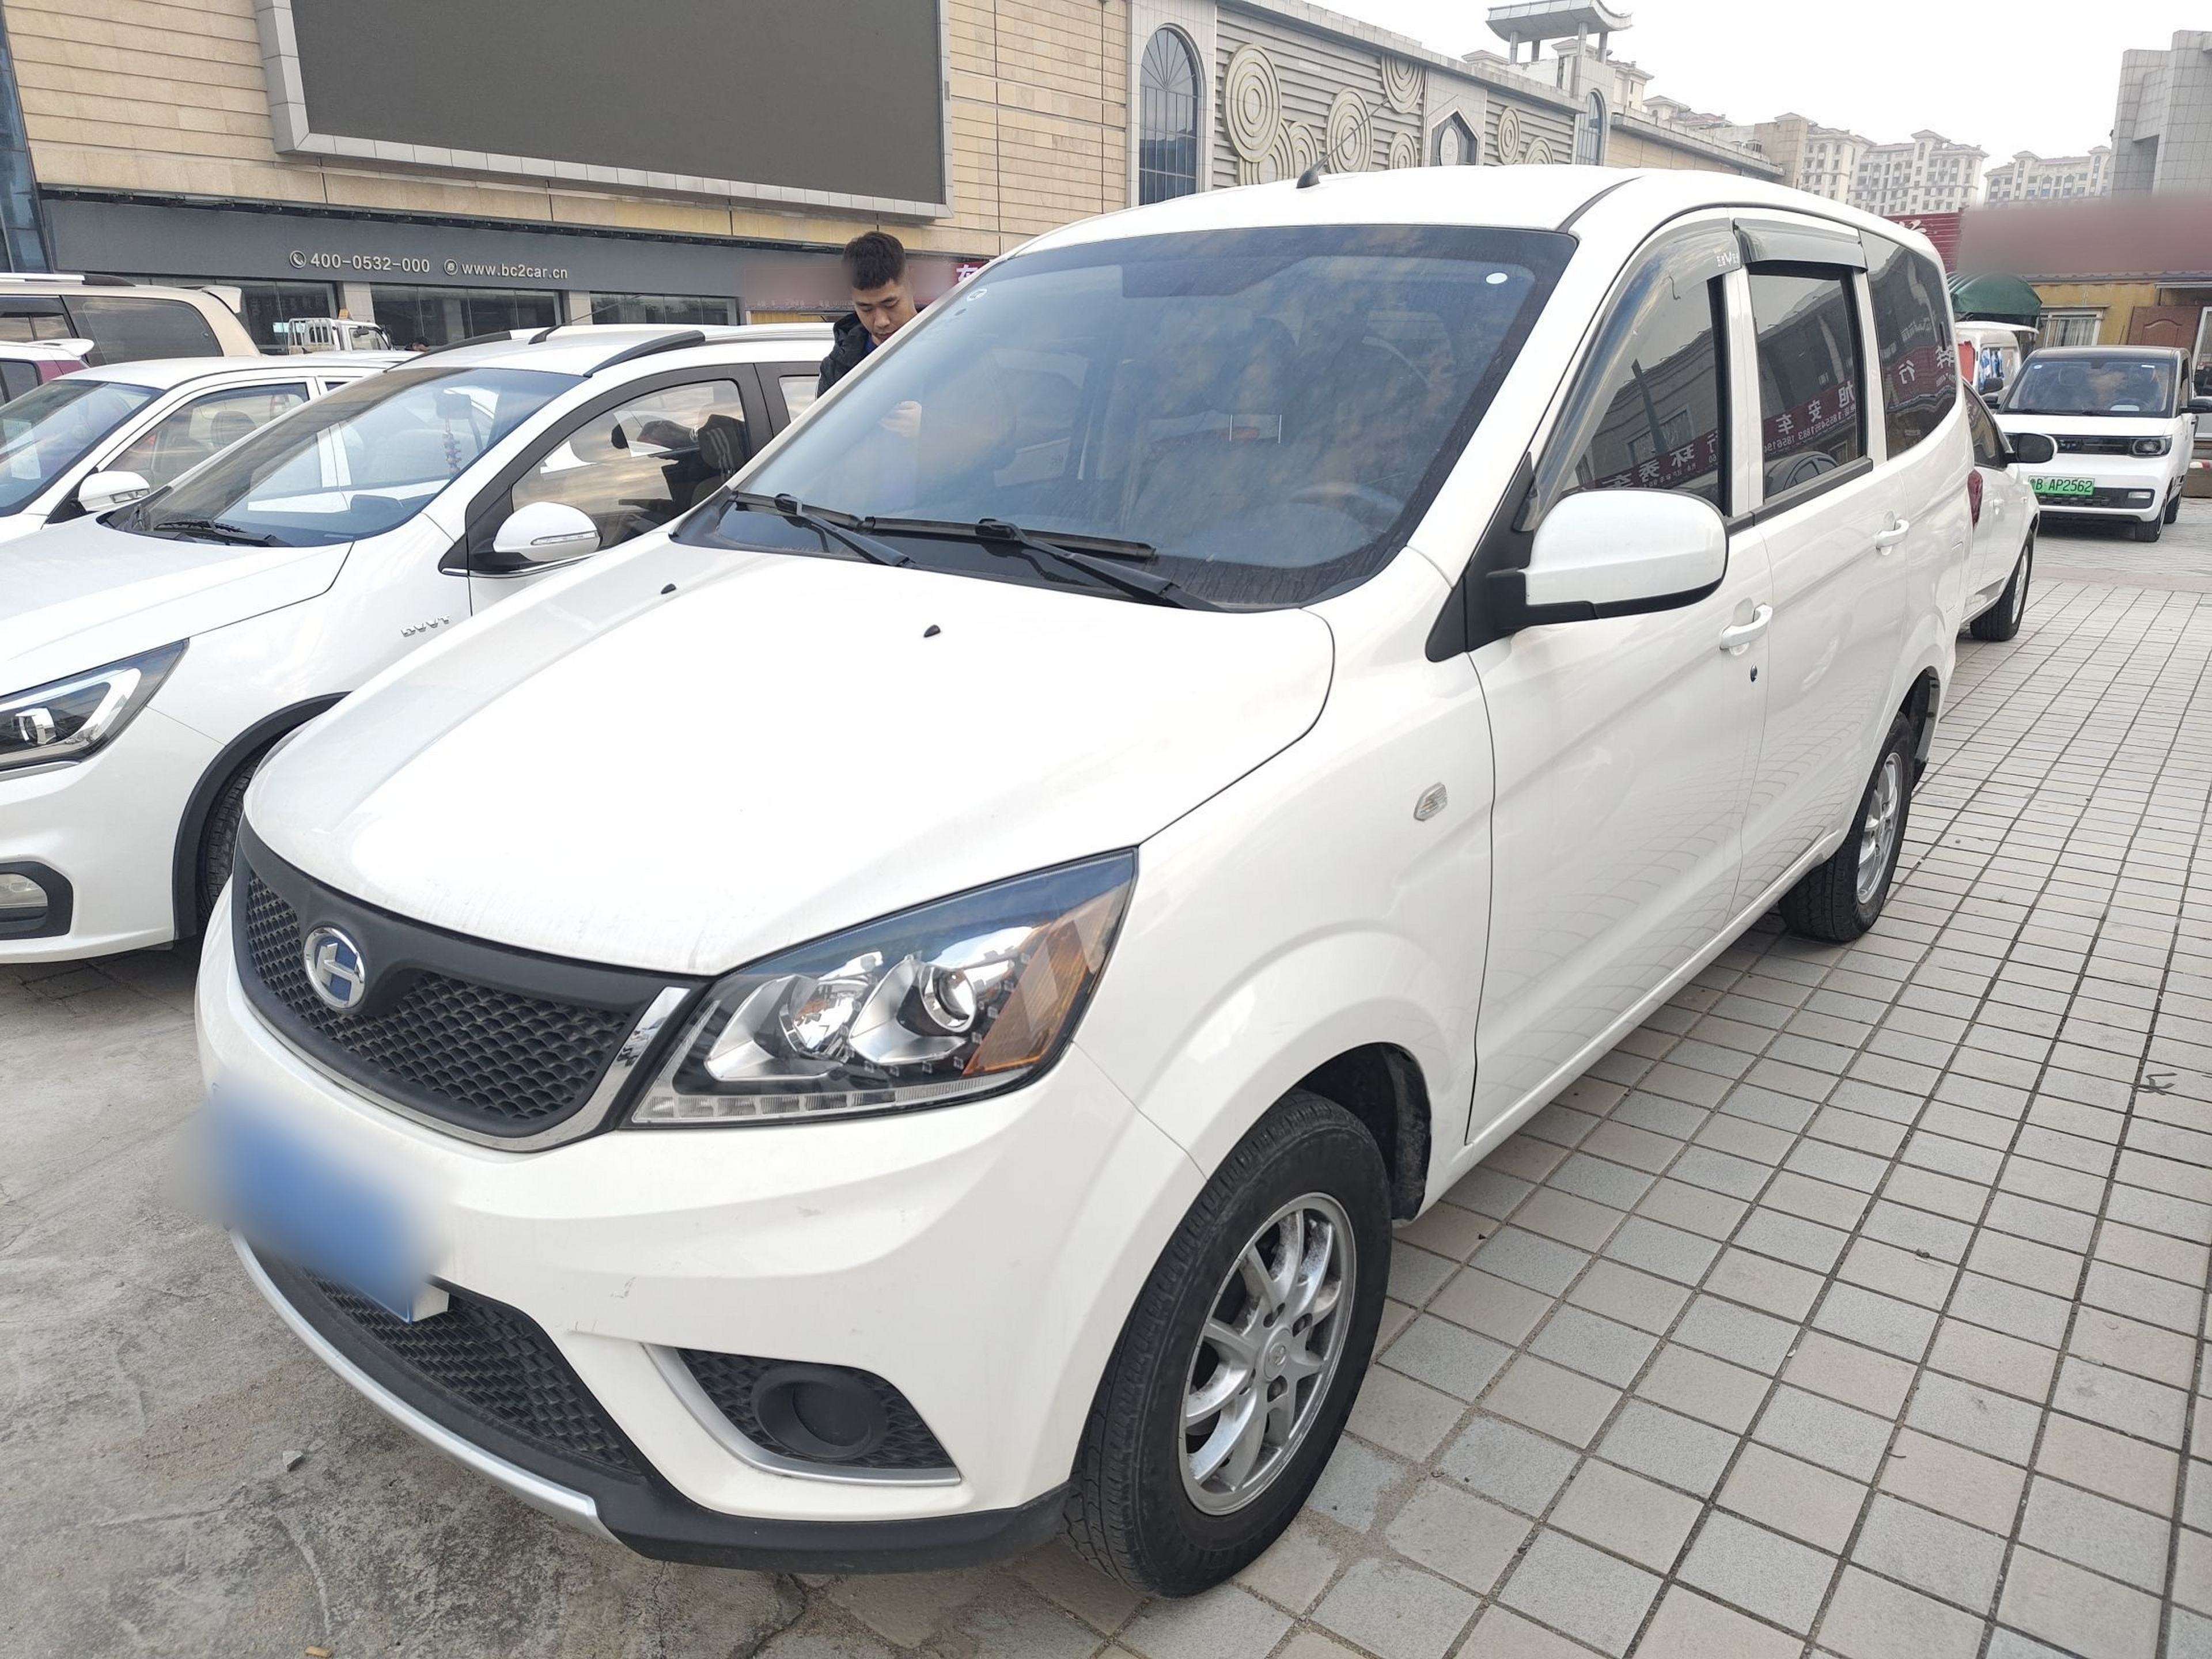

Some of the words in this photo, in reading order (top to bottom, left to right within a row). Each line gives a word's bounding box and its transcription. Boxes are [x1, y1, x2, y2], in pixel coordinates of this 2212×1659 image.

[310, 253, 430, 274] 400-0532-000
[461, 263, 569, 280] www.bc2car.cn
[2048, 478, 2093, 493] AP2562
